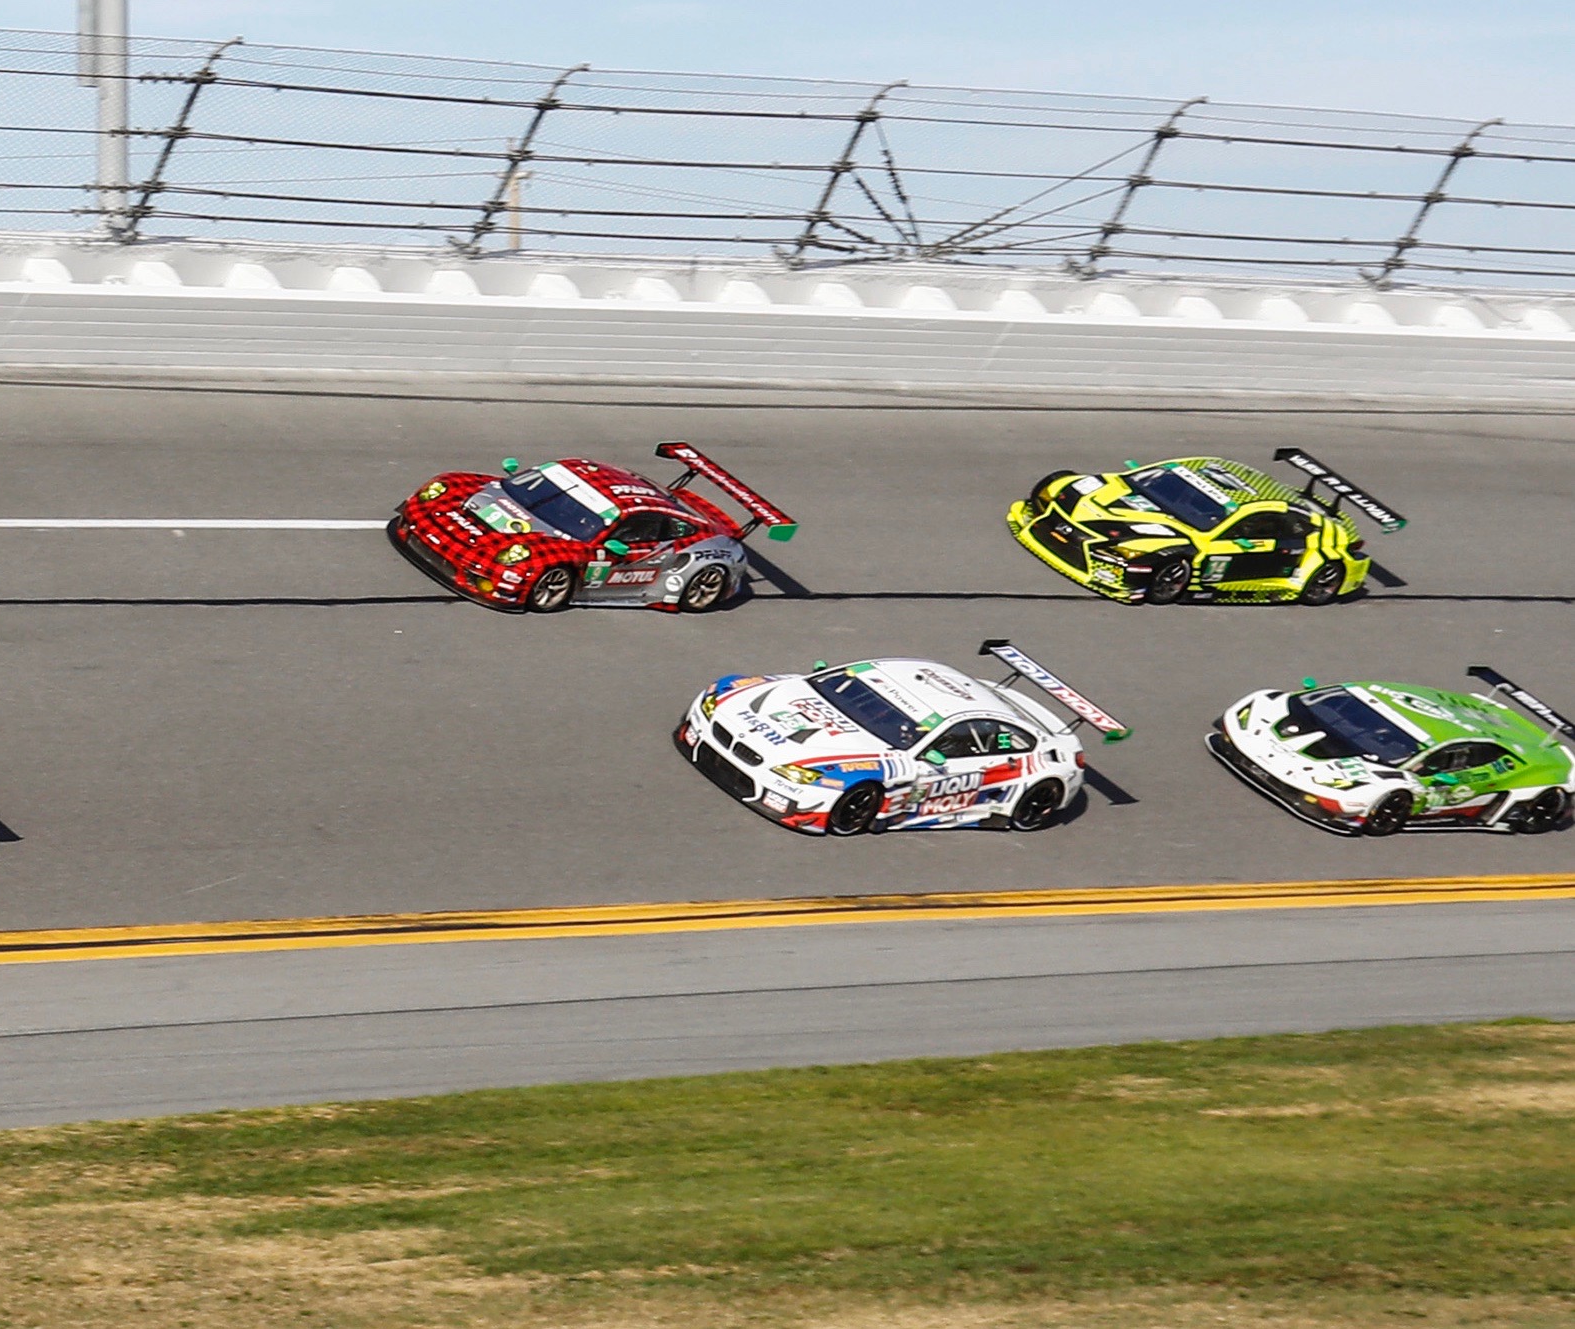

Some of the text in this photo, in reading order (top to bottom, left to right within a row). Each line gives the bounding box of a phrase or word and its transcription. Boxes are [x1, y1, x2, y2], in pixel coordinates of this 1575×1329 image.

[497, 498, 532, 521] MOTUL
[608, 569, 658, 583] MOTUL
[1001, 647, 1063, 691] LIQUI
[1054, 687, 1121, 732] MOLY
[929, 772, 982, 798] LIQUI
[922, 792, 976, 815] MOLY
